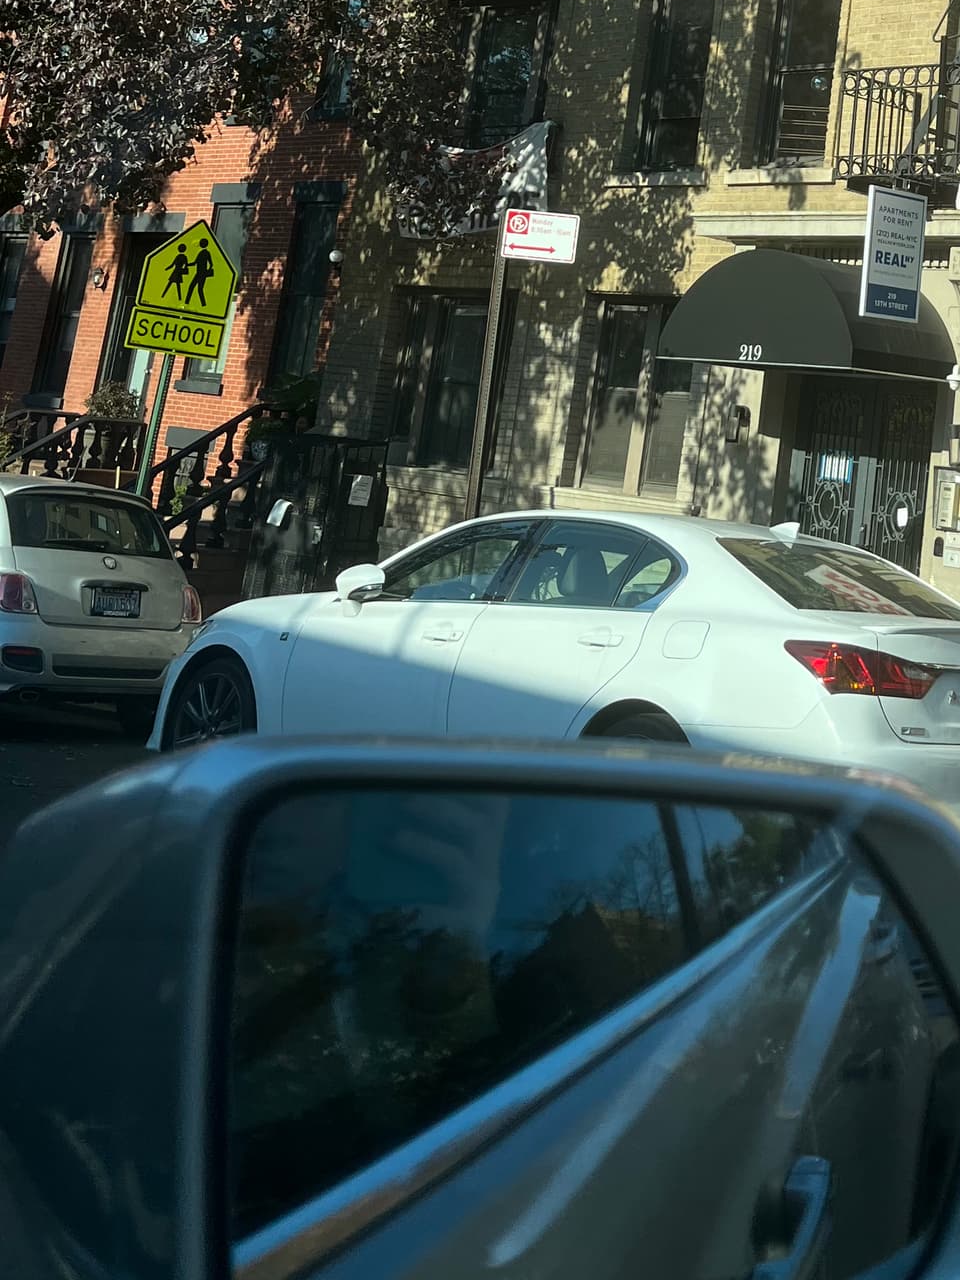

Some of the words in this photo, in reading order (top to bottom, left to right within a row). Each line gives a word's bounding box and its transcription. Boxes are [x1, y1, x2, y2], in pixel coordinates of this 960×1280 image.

[879, 205, 919, 220] APARTMENTS
[883, 215, 896, 225] FOR
[897, 218, 913, 228] RENT
[888, 302, 909, 311] STREET
[136, 318, 215, 348] SCHOOL
[739, 344, 762, 360] 219
